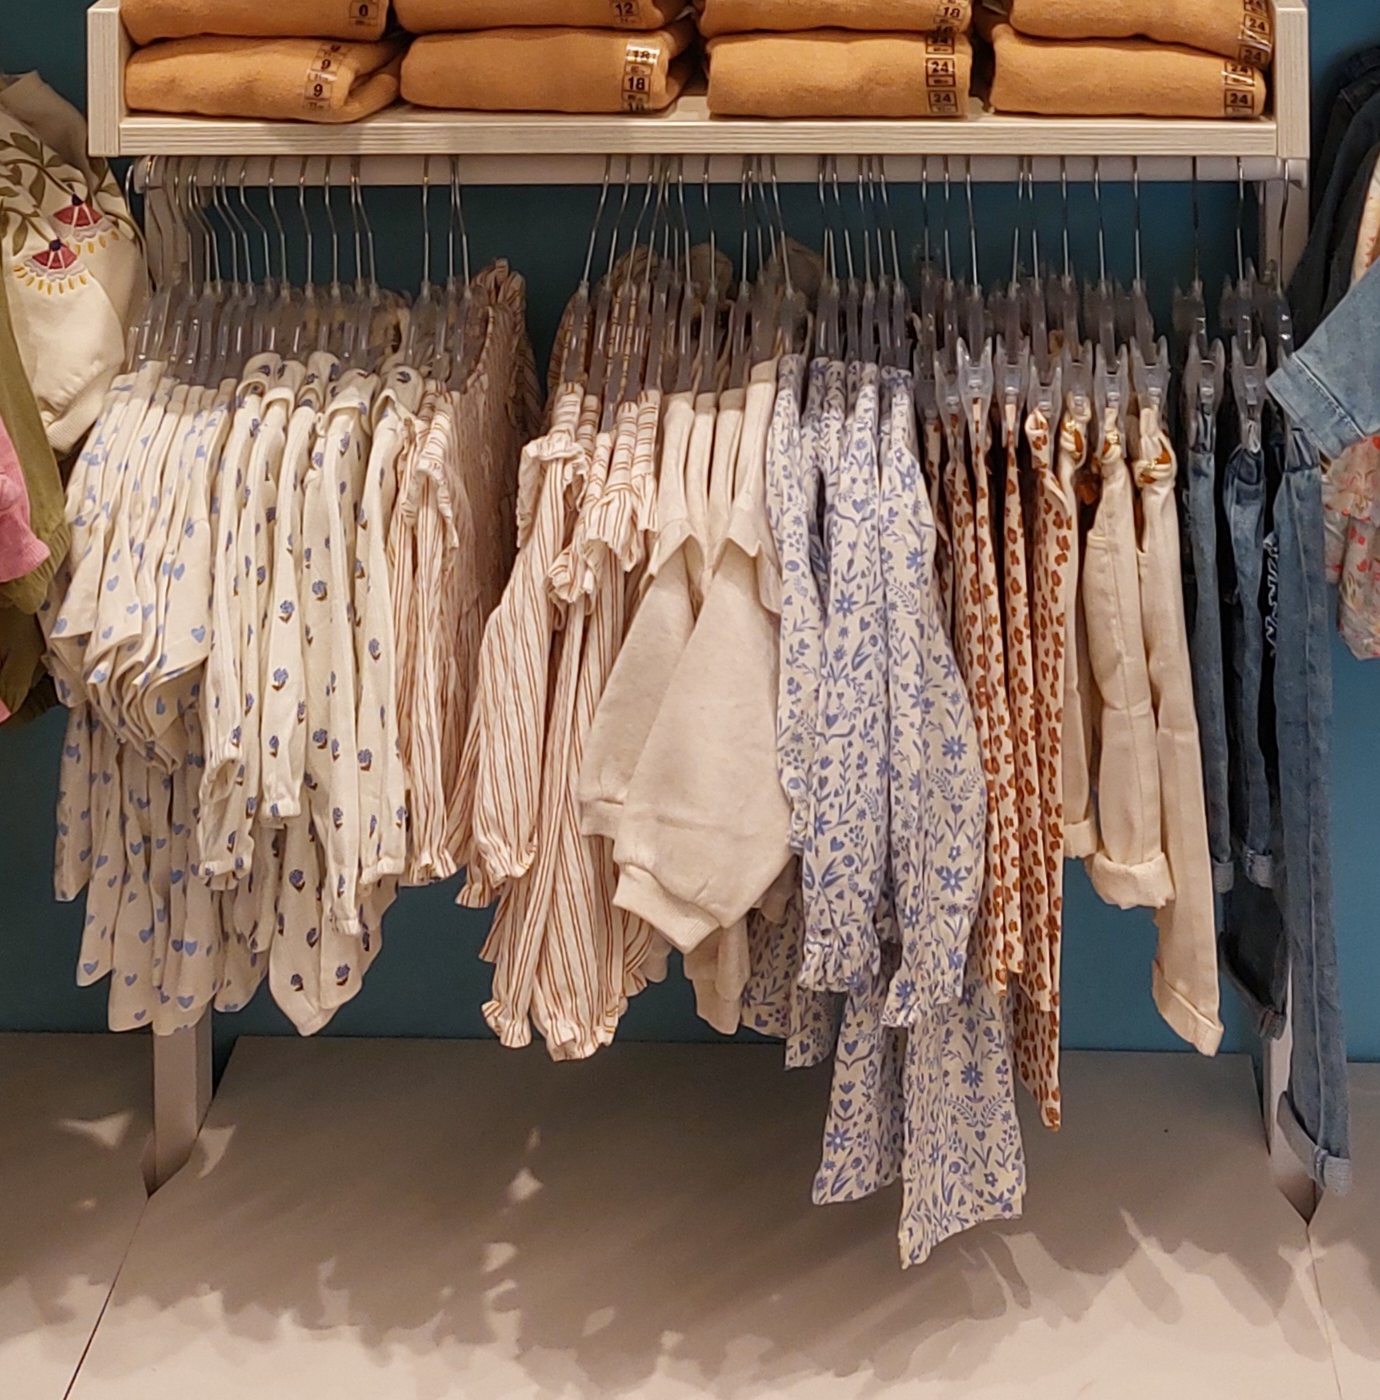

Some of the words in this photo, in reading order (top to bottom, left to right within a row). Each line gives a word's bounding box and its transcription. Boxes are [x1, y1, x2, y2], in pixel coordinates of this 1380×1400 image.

[615, 2, 633, 16] 12
[943, 6, 960, 18] 18
[1249, 18, 1265, 31] 24
[321, 59, 331, 70] 9
[931, 61, 949, 73] 24
[628, 76, 645, 90] 18
[313, 83, 323, 97] 9
[933, 93, 951, 104] 24
[1230, 93, 1248, 104] 24
